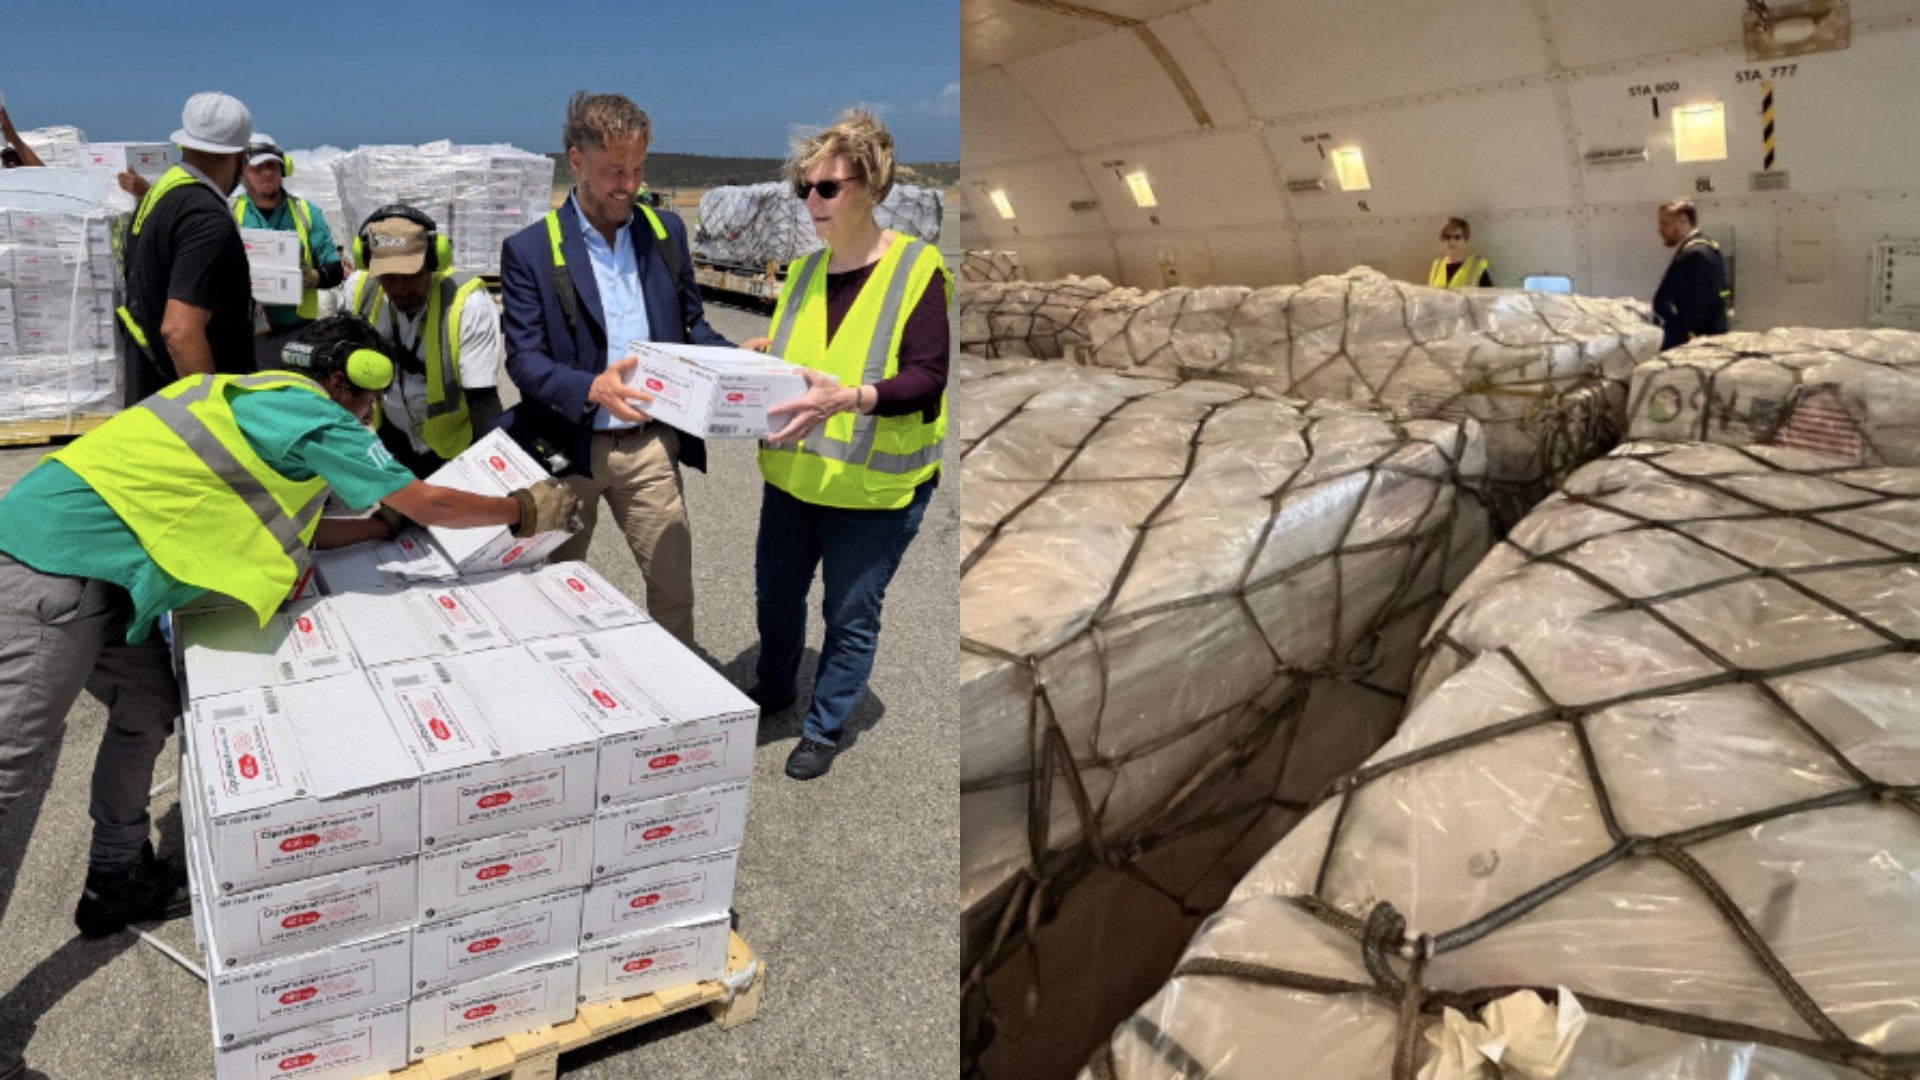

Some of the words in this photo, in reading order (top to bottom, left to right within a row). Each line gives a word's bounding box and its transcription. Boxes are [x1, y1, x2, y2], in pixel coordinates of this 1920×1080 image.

[1735, 70, 1762, 83] STA
[1770, 64, 1797, 78] 777
[1628, 84, 1651, 96] STA
